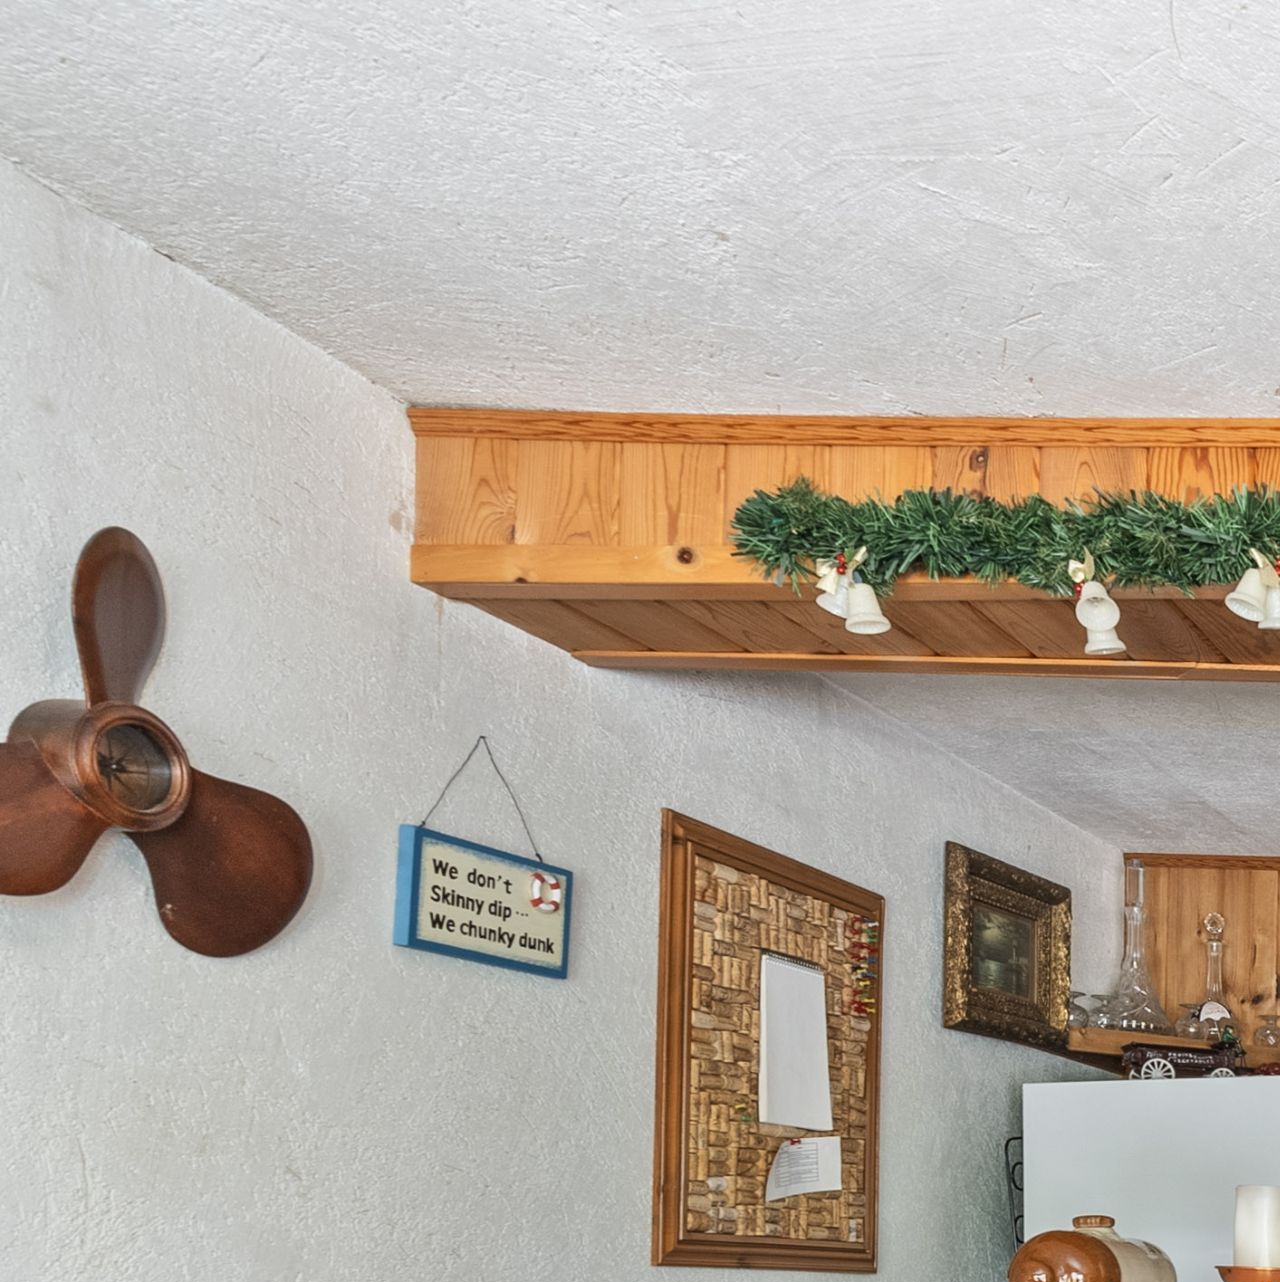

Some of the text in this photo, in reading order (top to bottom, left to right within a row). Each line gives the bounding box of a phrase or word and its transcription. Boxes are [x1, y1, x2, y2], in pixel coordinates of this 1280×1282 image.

[432, 858, 514, 894] We don't
[430, 884, 484, 915] Skinny
[488, 900, 512, 922] dip
[429, 912, 555, 955] We chunky dunk
